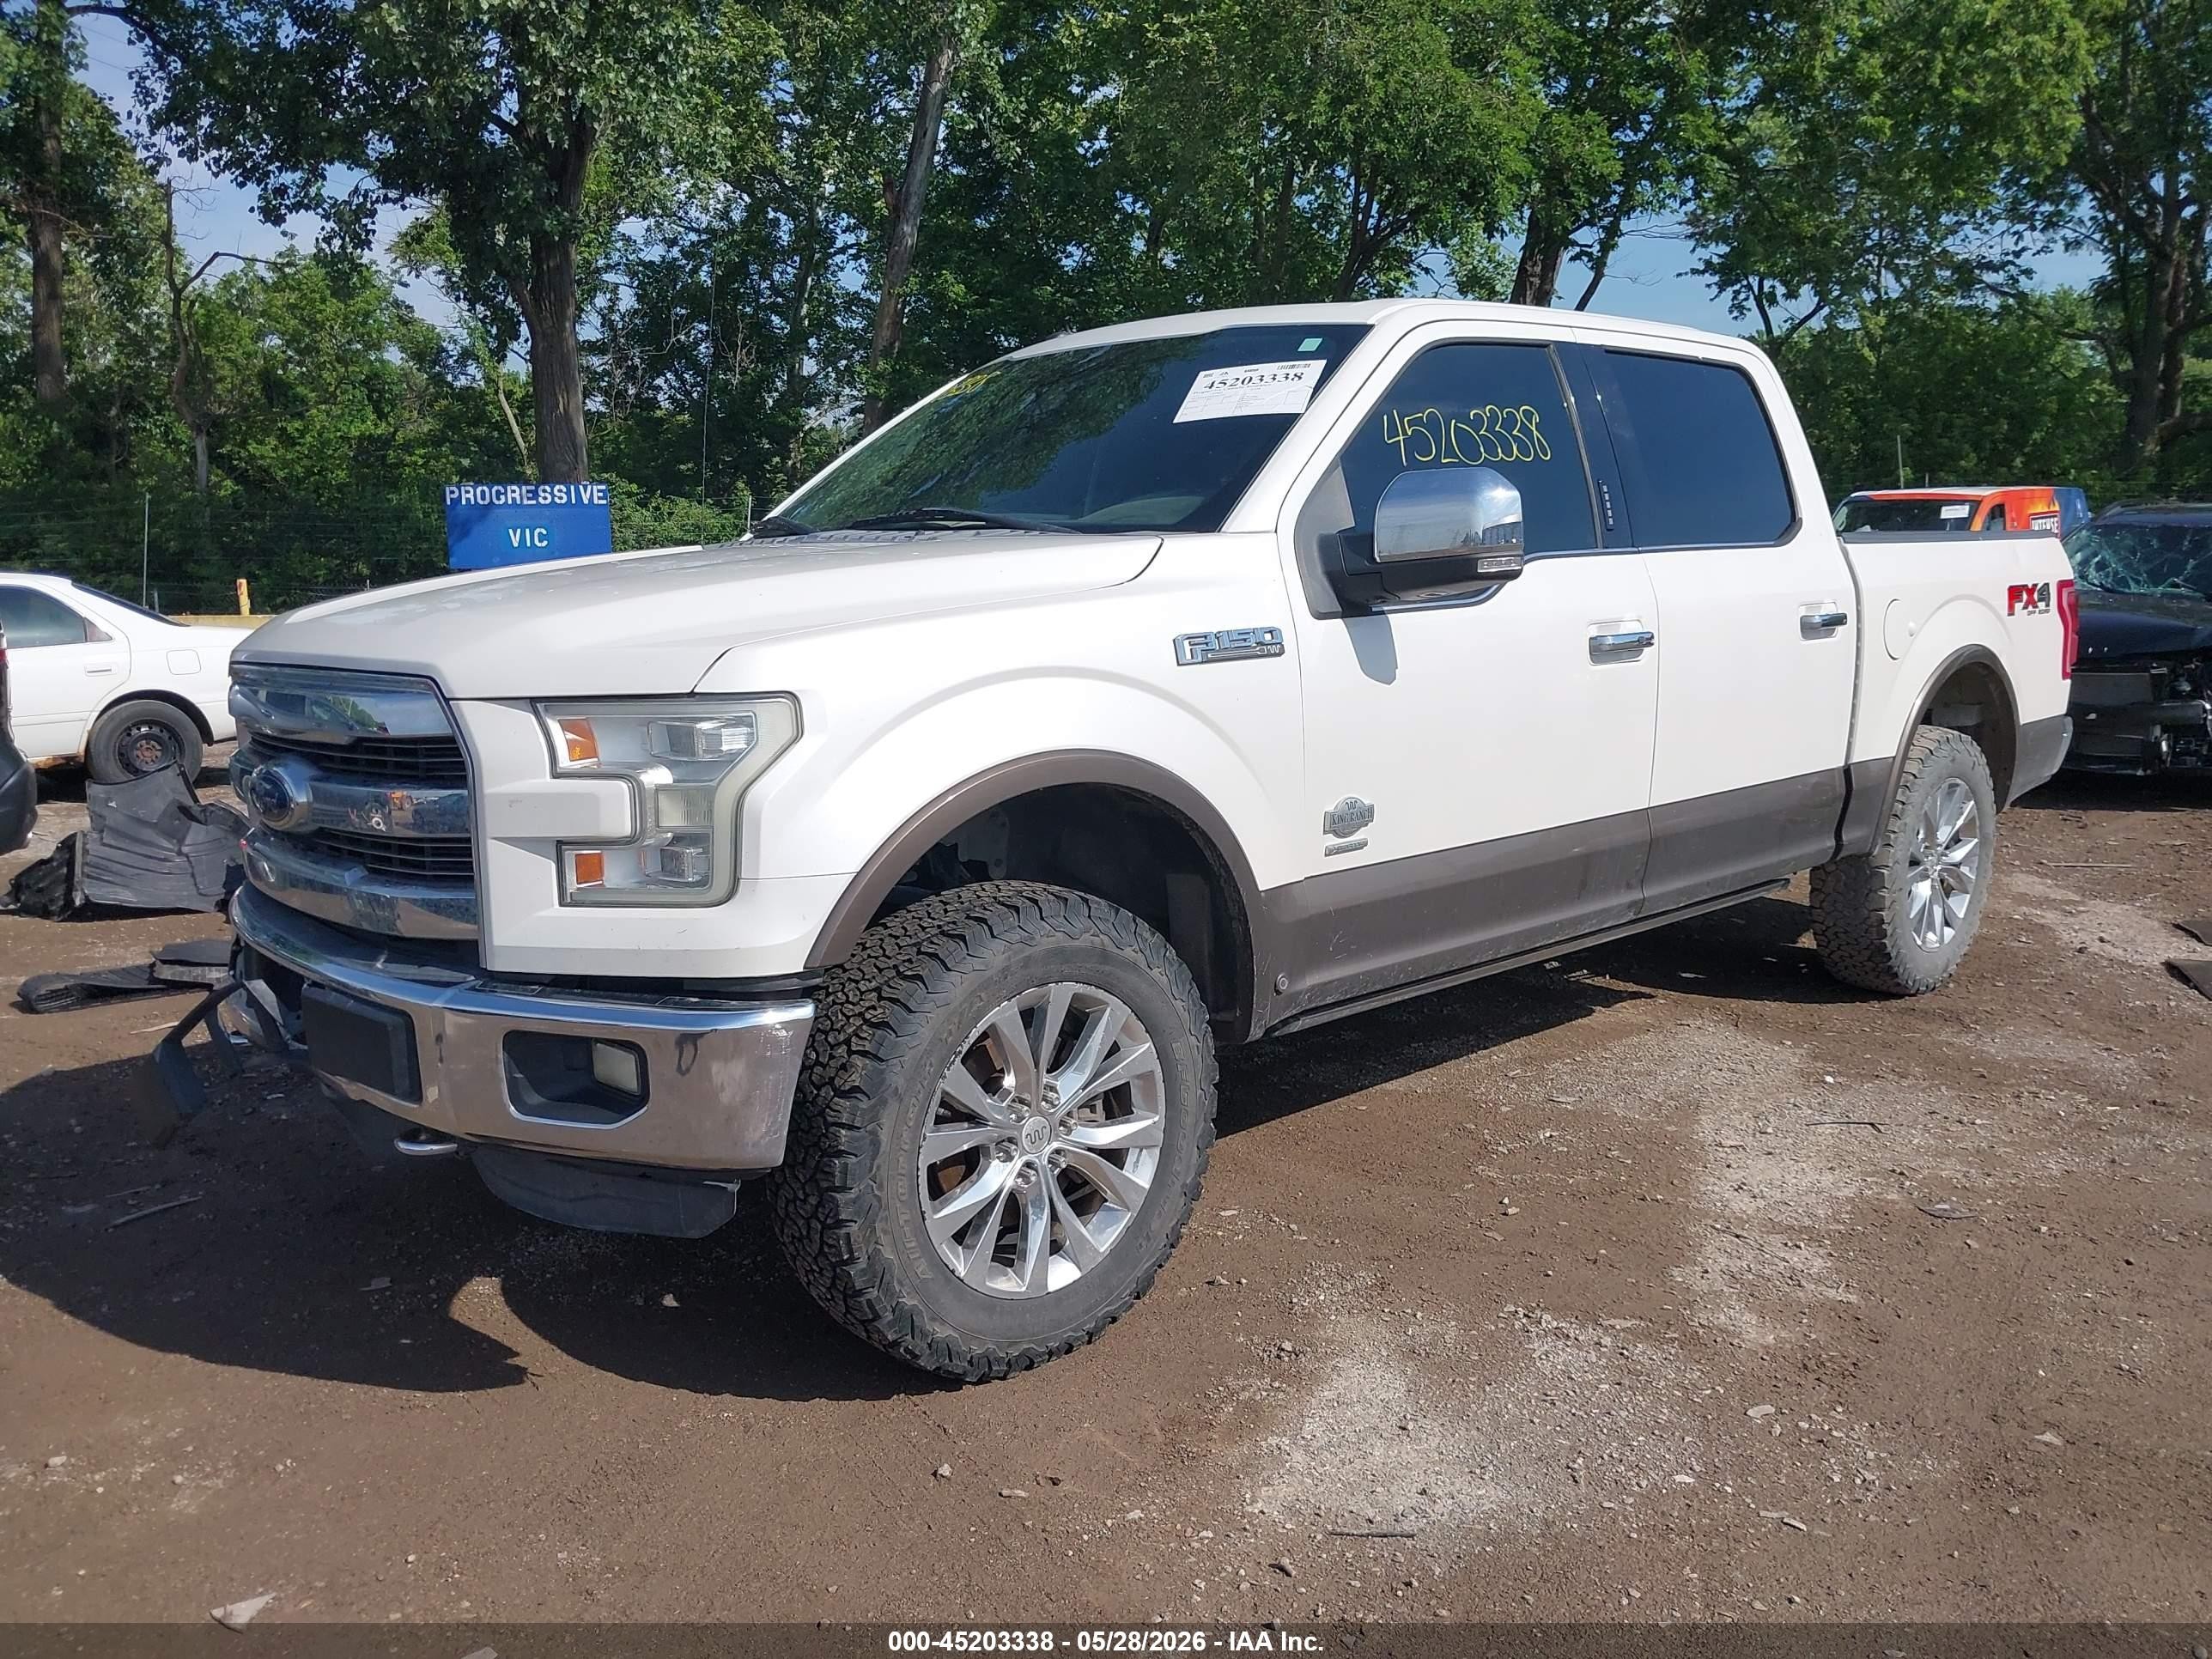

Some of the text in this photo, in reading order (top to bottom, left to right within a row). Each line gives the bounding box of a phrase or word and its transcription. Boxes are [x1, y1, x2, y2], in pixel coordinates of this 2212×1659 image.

[1204, 372, 1304, 390] 45203338
[1383, 405, 1551, 467] 45203338
[446, 485, 607, 505] PROGRESSIVE
[508, 528, 548, 547] VIC
[2007, 582, 2051, 617] FX4
[1332, 807, 1373, 825] KING RANCH
